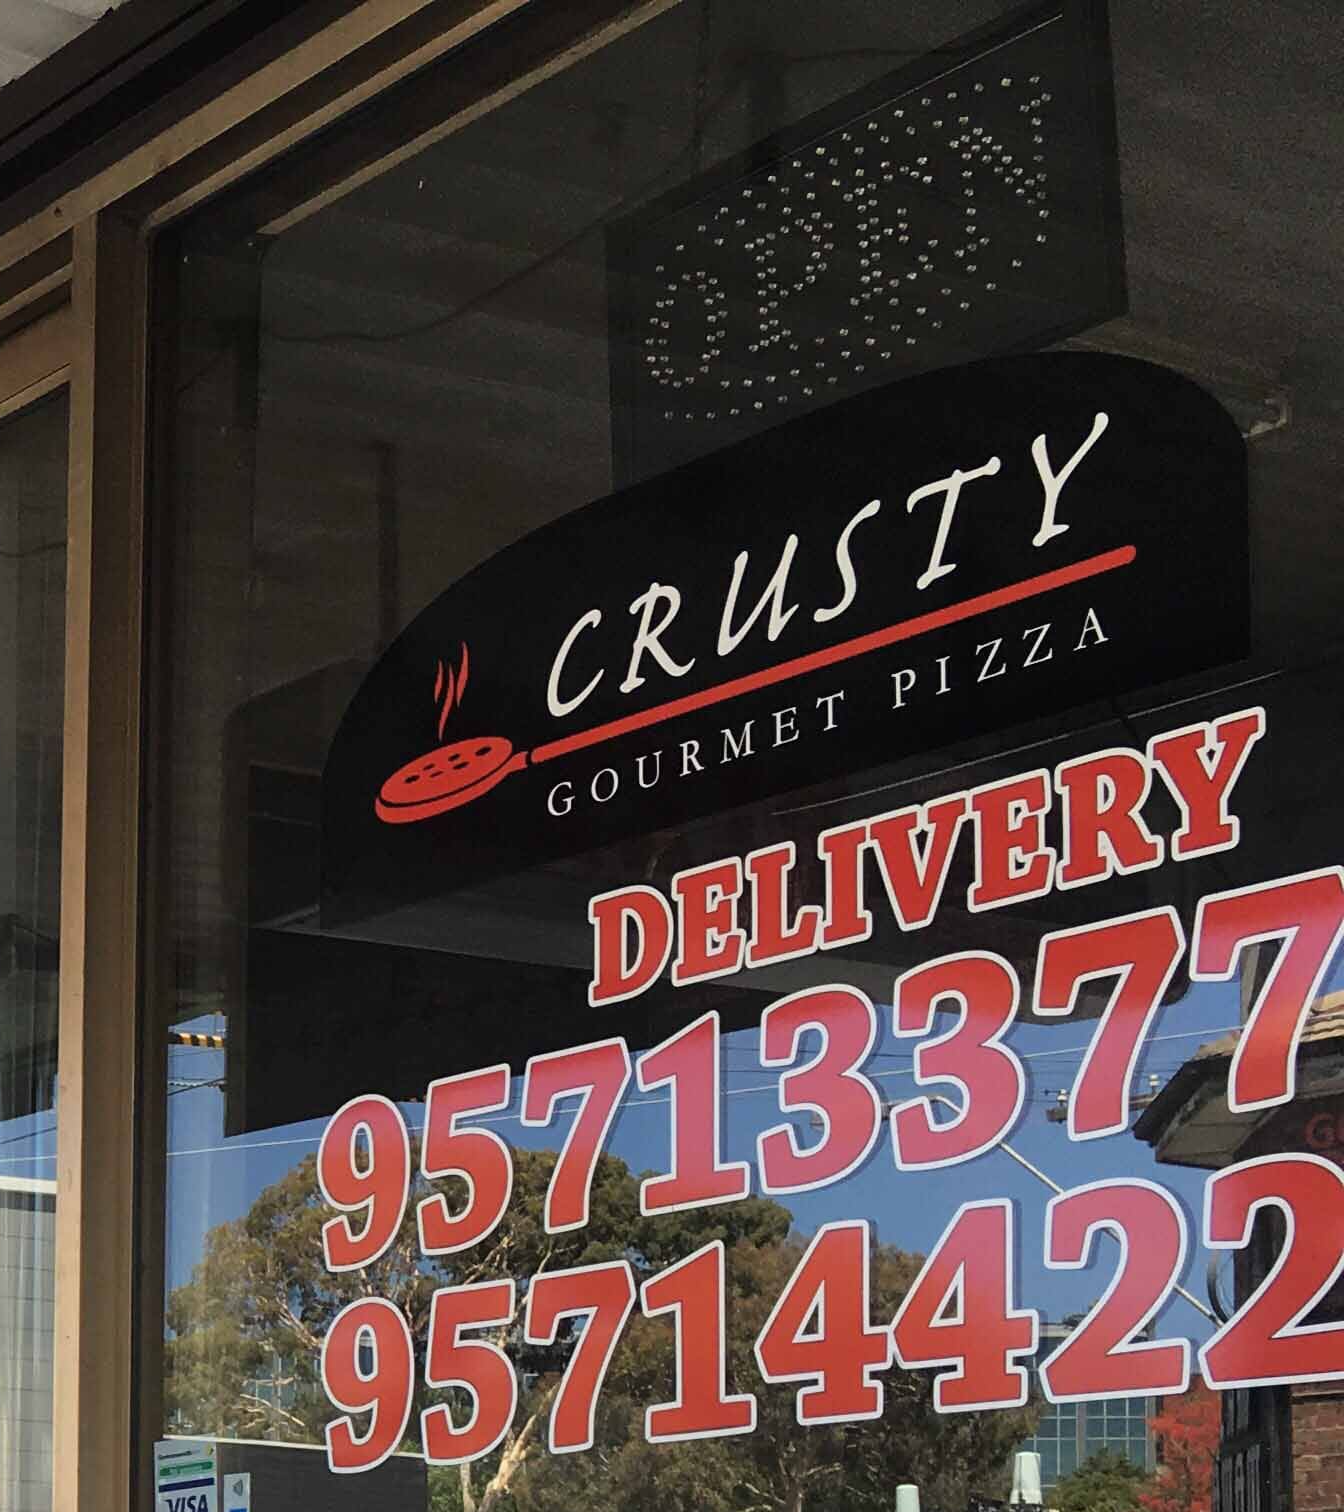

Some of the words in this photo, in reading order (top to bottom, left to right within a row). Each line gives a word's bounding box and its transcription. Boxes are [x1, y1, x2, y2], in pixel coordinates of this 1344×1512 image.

[544, 411, 1111, 718] CRUSTY
[546, 690, 849, 818] GOURMET
[891, 605, 1111, 711] PIZZA
[587, 706, 1266, 1007] DELIVERY
[317, 866, 1344, 1273] 95713377
[319, 1150, 1344, 1475] 95714422
